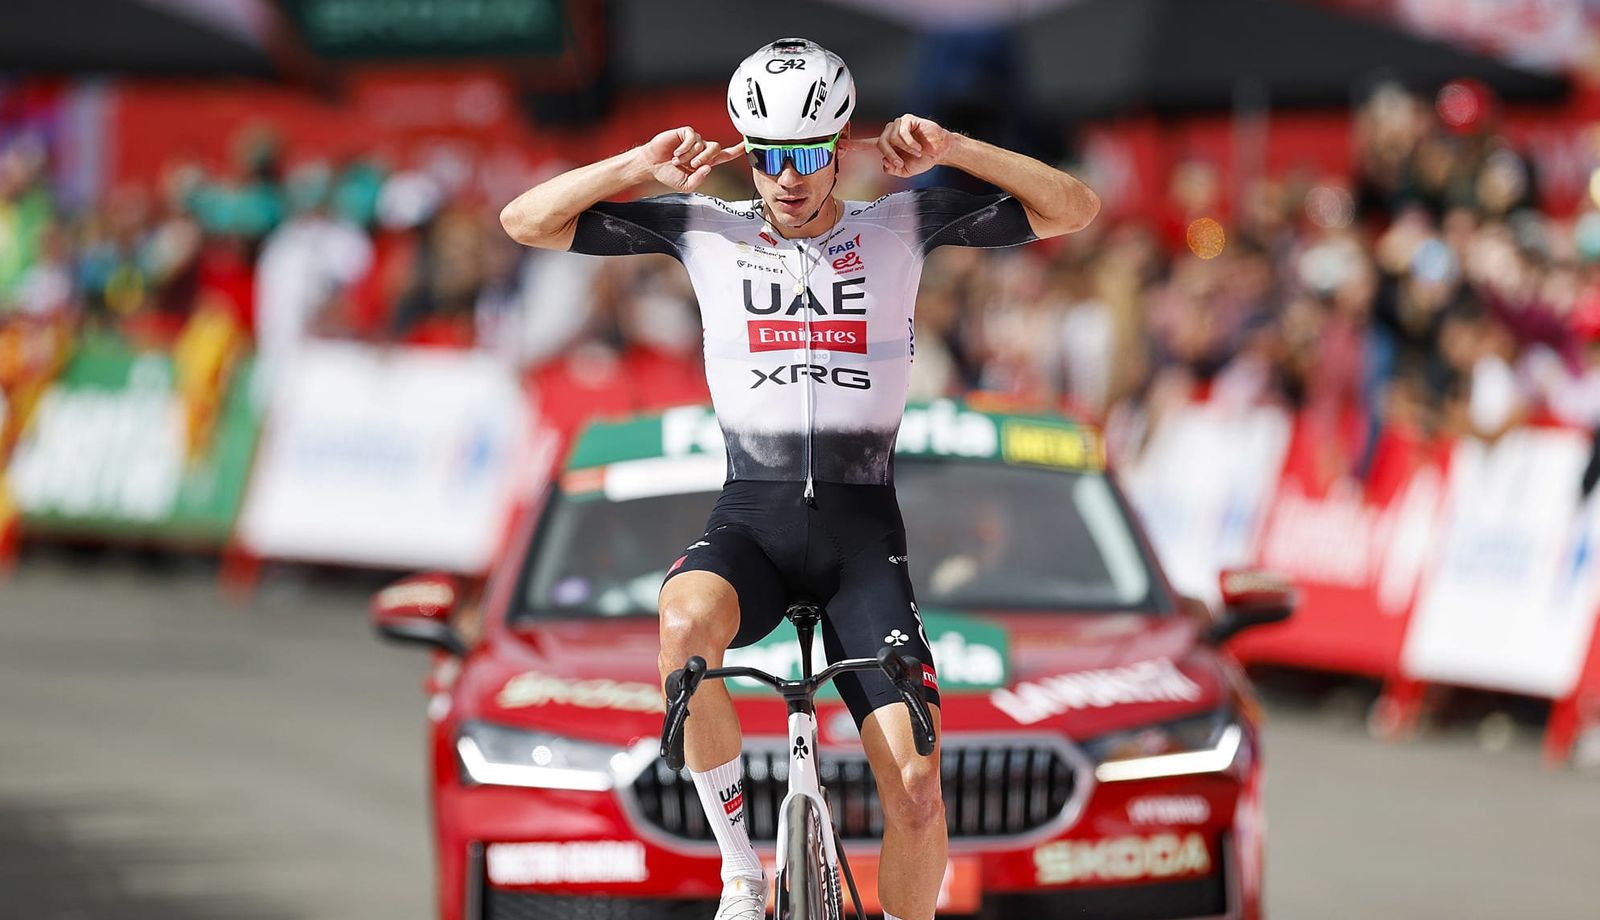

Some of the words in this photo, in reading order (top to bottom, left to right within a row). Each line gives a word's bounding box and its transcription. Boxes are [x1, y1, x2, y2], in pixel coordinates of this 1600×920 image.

[765, 58, 806, 75] G42
[745, 76, 761, 120] MET
[809, 76, 829, 122] MET
[746, 263, 784, 275] PISSEI
[742, 276, 867, 316] UAE
[749, 363, 872, 391] XRG
